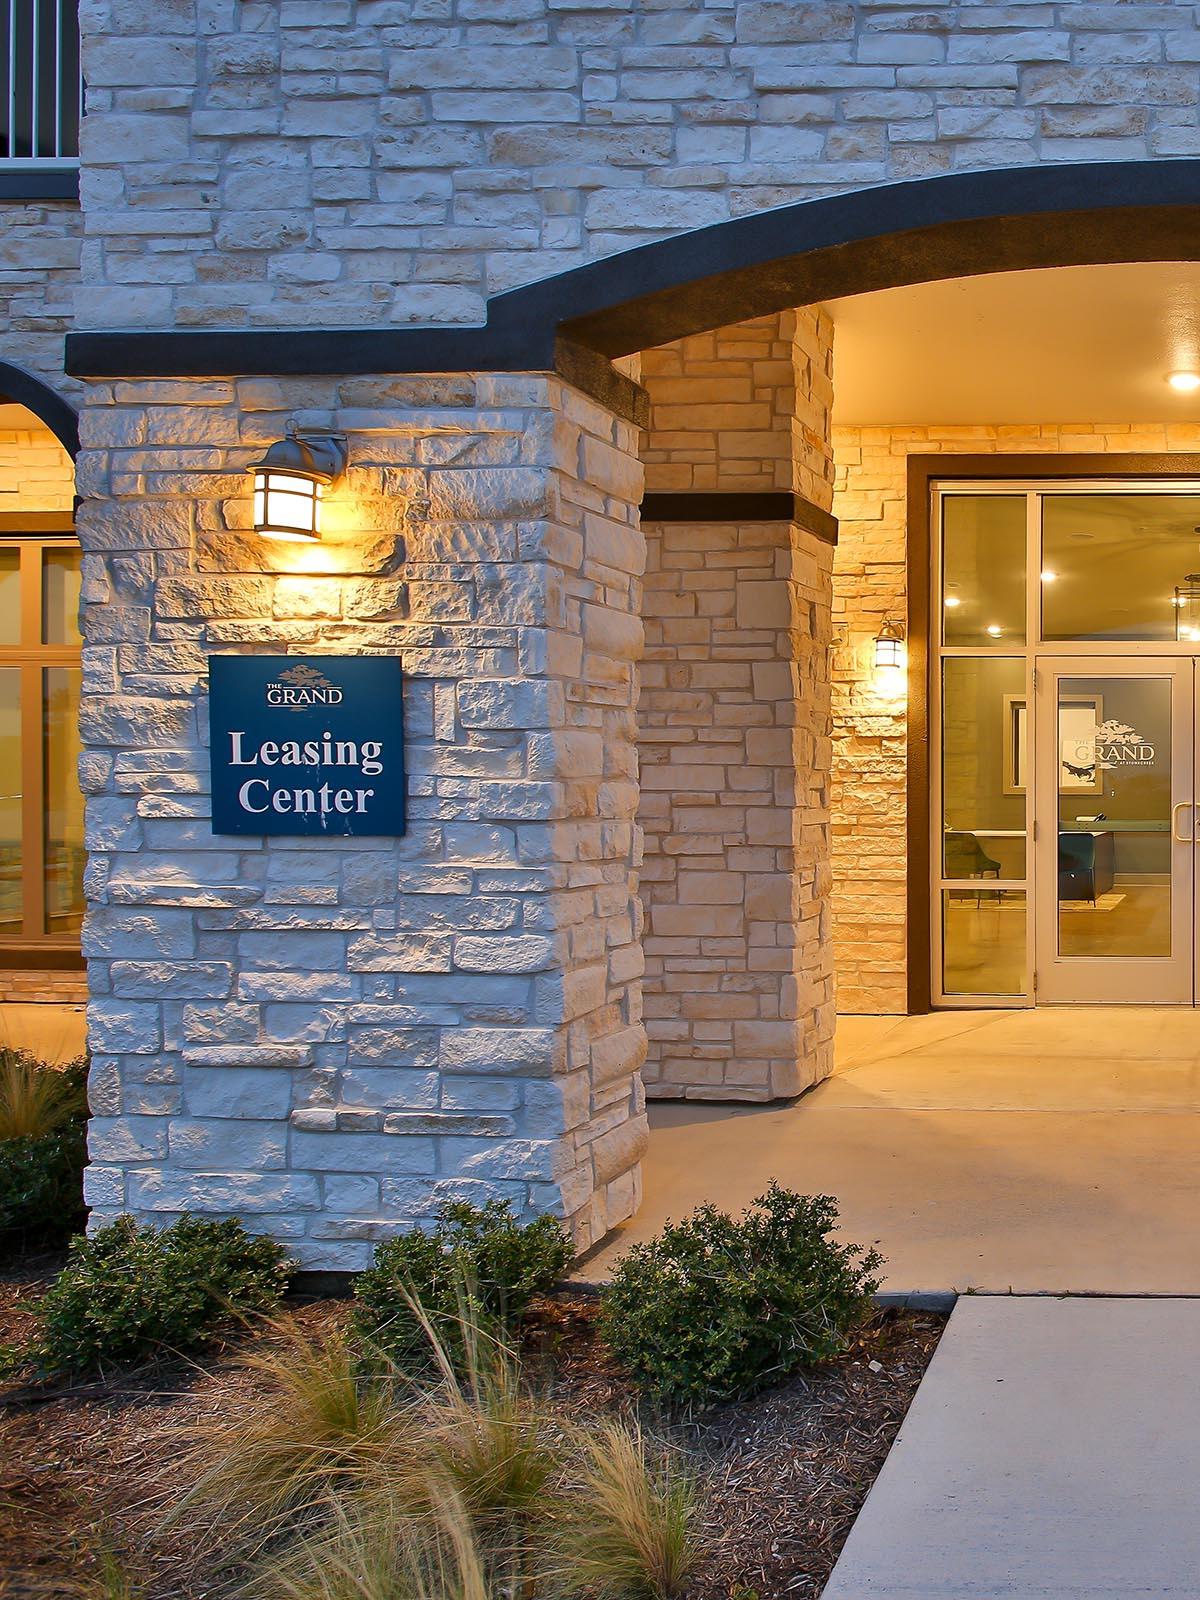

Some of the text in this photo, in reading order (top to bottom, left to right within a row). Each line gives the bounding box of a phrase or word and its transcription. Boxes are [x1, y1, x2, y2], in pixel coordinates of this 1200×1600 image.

[267, 689, 343, 704] GRAND
[227, 731, 384, 776] Leasing
[1075, 745, 1155, 761] GRAND
[238, 779, 375, 814] Center
